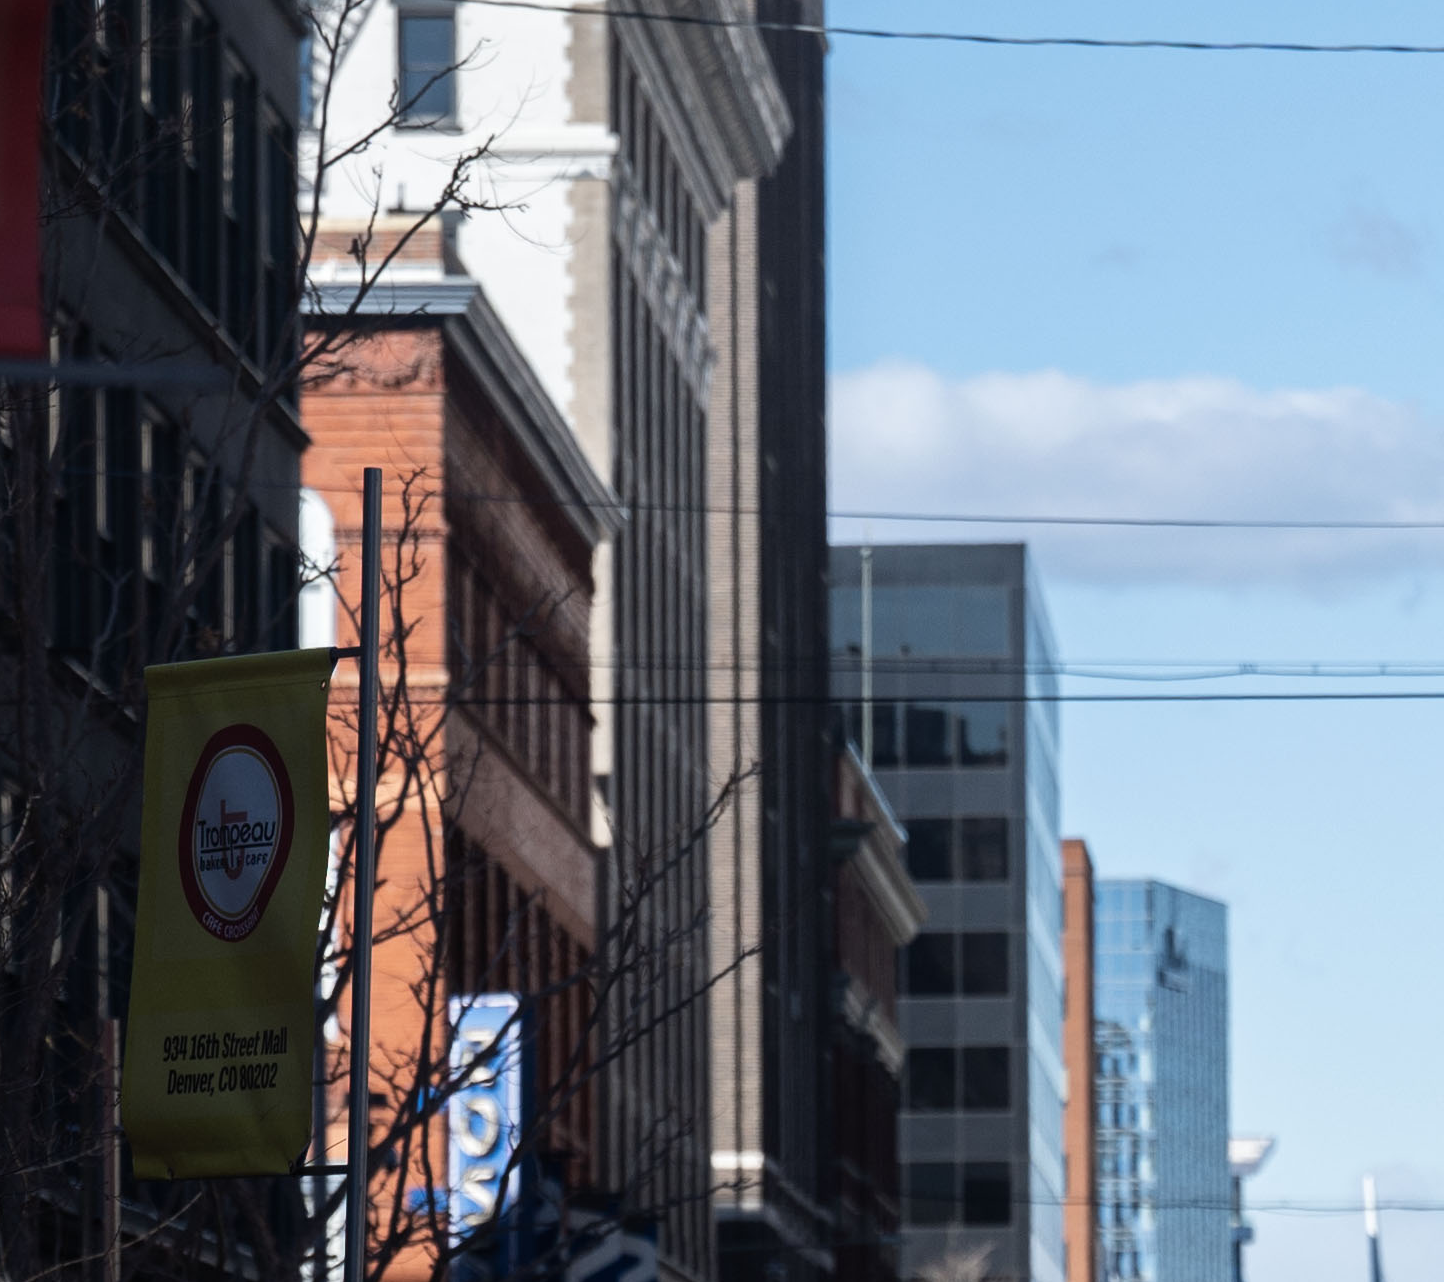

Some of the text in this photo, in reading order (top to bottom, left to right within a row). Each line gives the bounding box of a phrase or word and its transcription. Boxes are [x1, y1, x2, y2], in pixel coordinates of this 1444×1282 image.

[198, 820, 276, 860] Trompeau
[163, 1026, 289, 1063] 934 16th Street Mall
[167, 1061, 278, 1097] Denver, CO 80202
